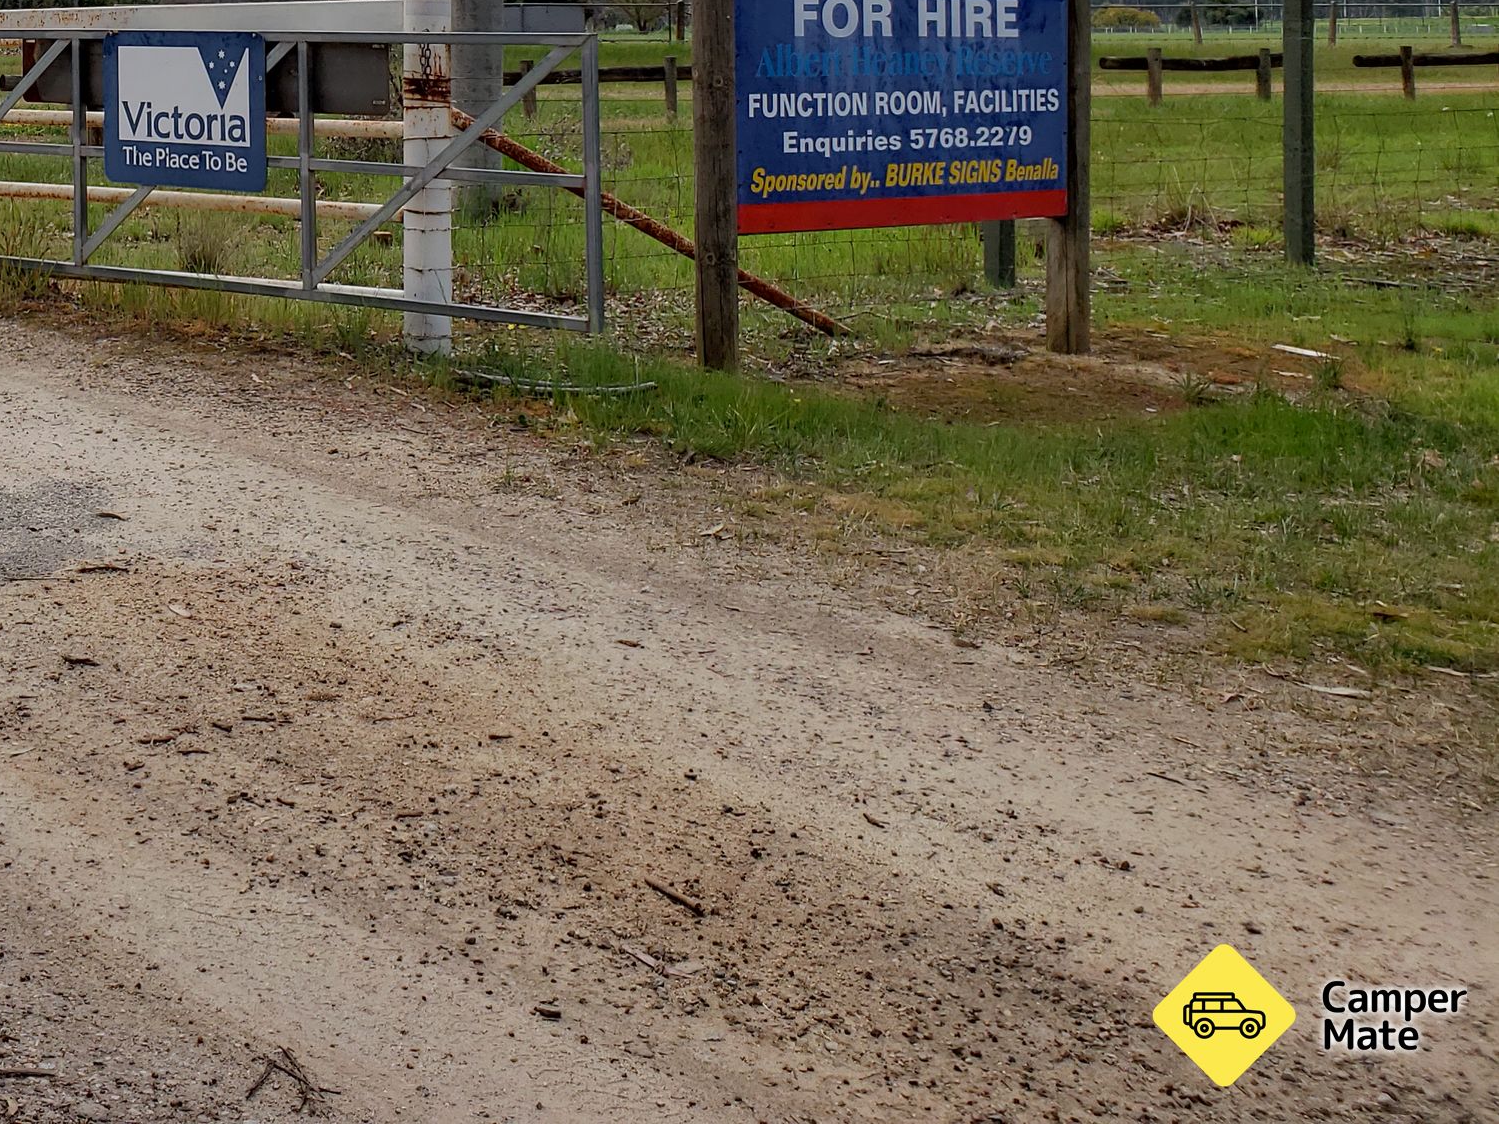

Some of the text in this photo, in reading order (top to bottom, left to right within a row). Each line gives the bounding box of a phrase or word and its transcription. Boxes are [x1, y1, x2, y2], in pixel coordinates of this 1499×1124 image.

[756, 42, 1053, 80] Albert Heaney Reserve
[747, 87, 1060, 119] FUNCTION ROOM, FACILITIES
[121, 100, 247, 143] Victoria
[122, 145, 248, 173] The Place To Be
[782, 125, 1033, 158] Enquiries 5768.2279
[750, 165, 847, 198] Sponsored
[885, 160, 947, 188] BURKE
[949, 159, 1002, 185] SIGNS
[1005, 156, 1060, 182] Benalla
